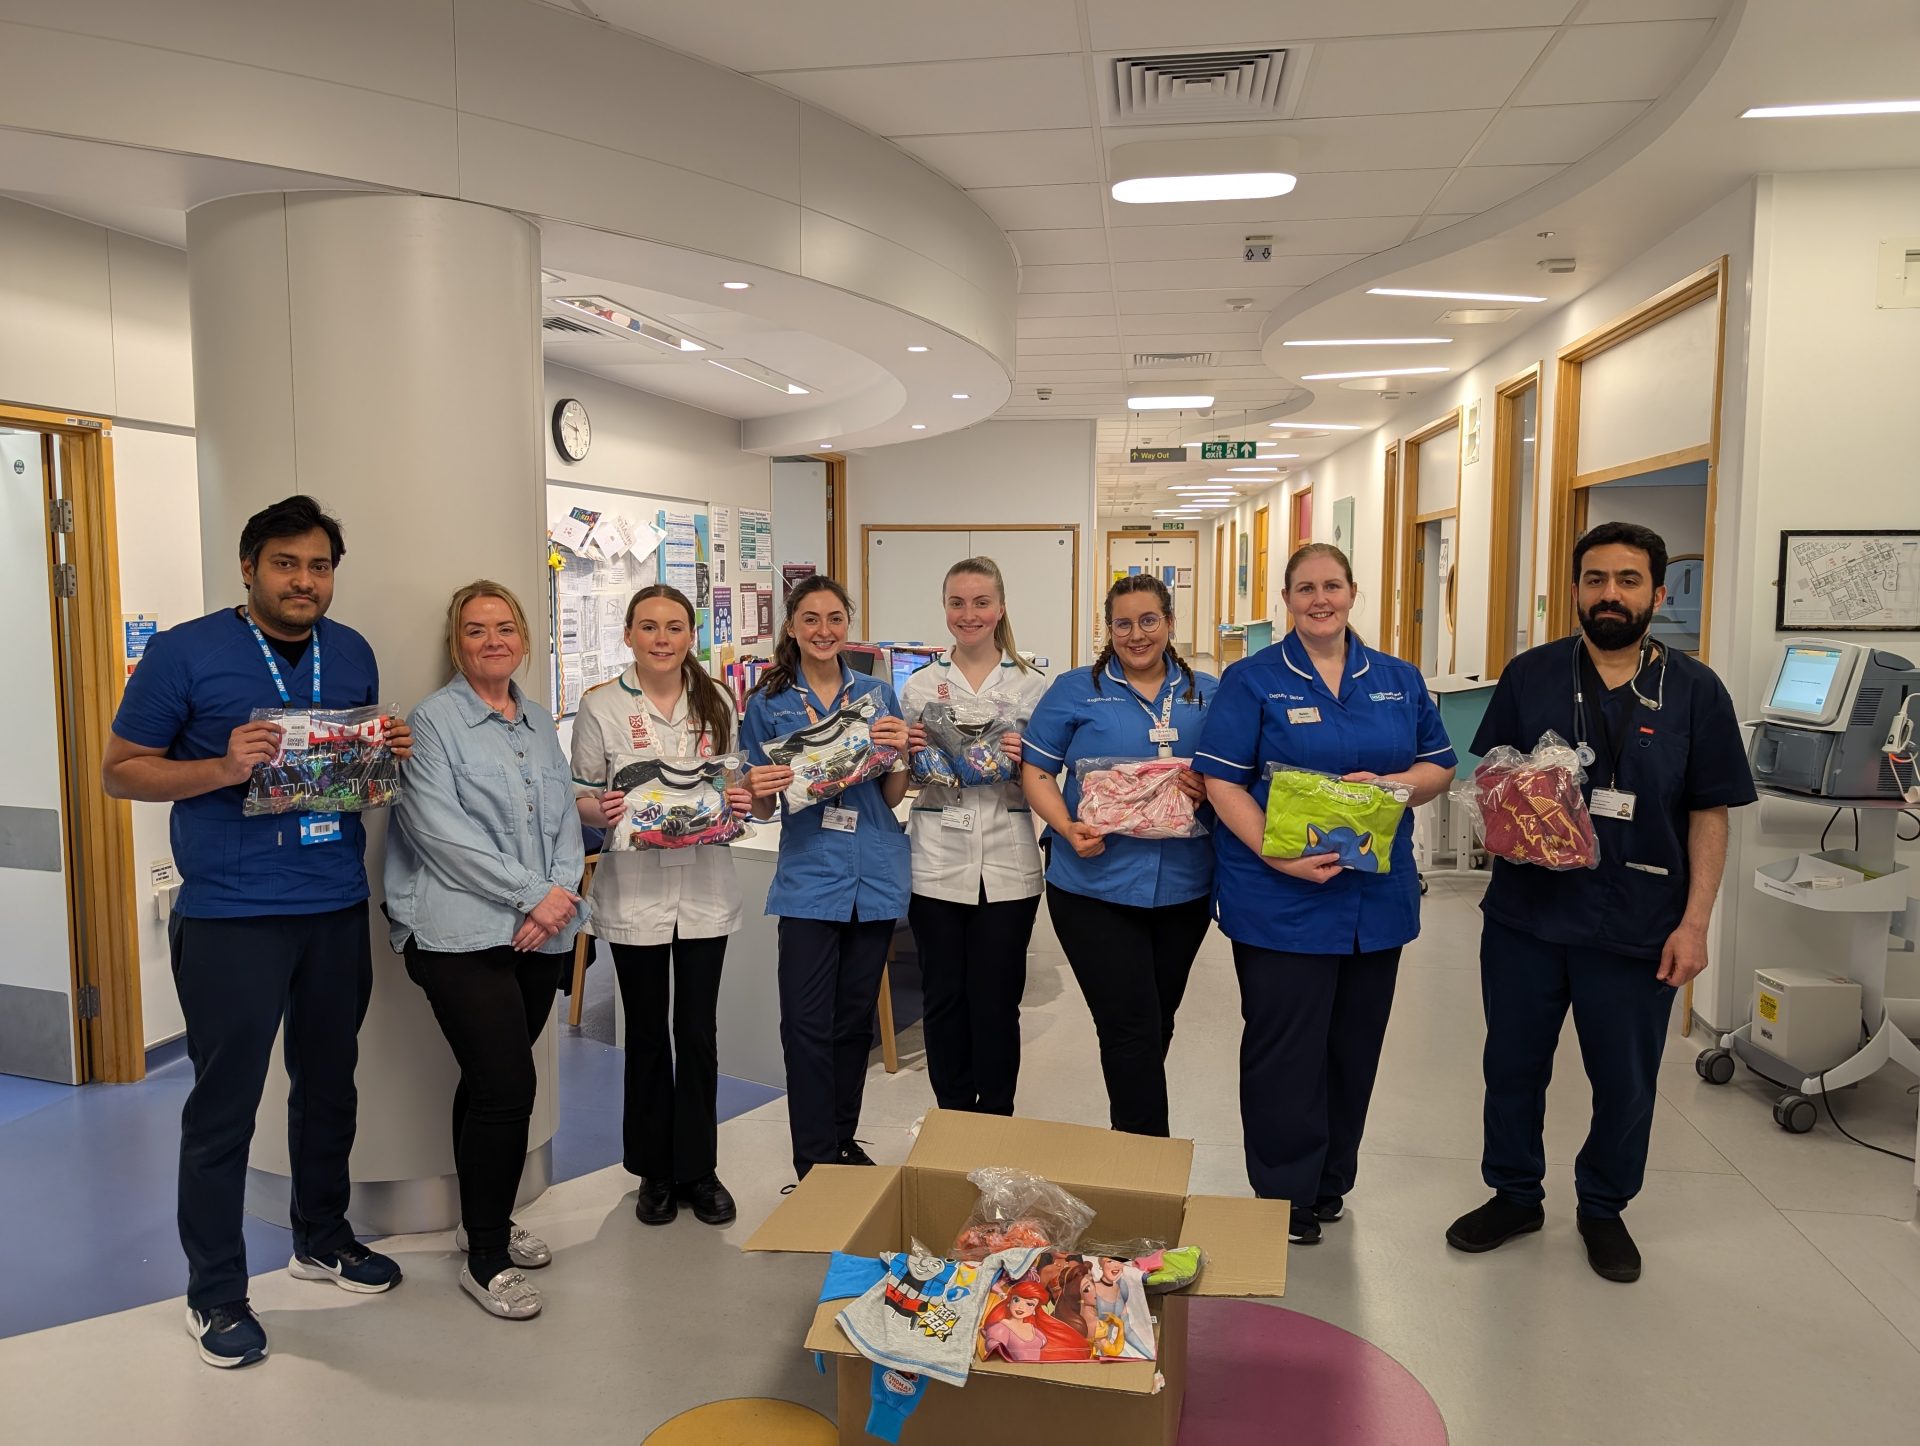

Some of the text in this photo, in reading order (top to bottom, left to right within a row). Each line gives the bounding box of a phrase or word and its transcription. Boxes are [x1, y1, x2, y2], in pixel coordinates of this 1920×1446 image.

[1205, 443, 1222, 452] Fire
[1141, 452, 1155, 460] Way
[1205, 451, 1222, 459] exit
[261, 644, 272, 658] NHS
[268, 661, 279, 675] NHS
[275, 678, 286, 692] NHS
[935, 1305, 956, 1322] PEEP
